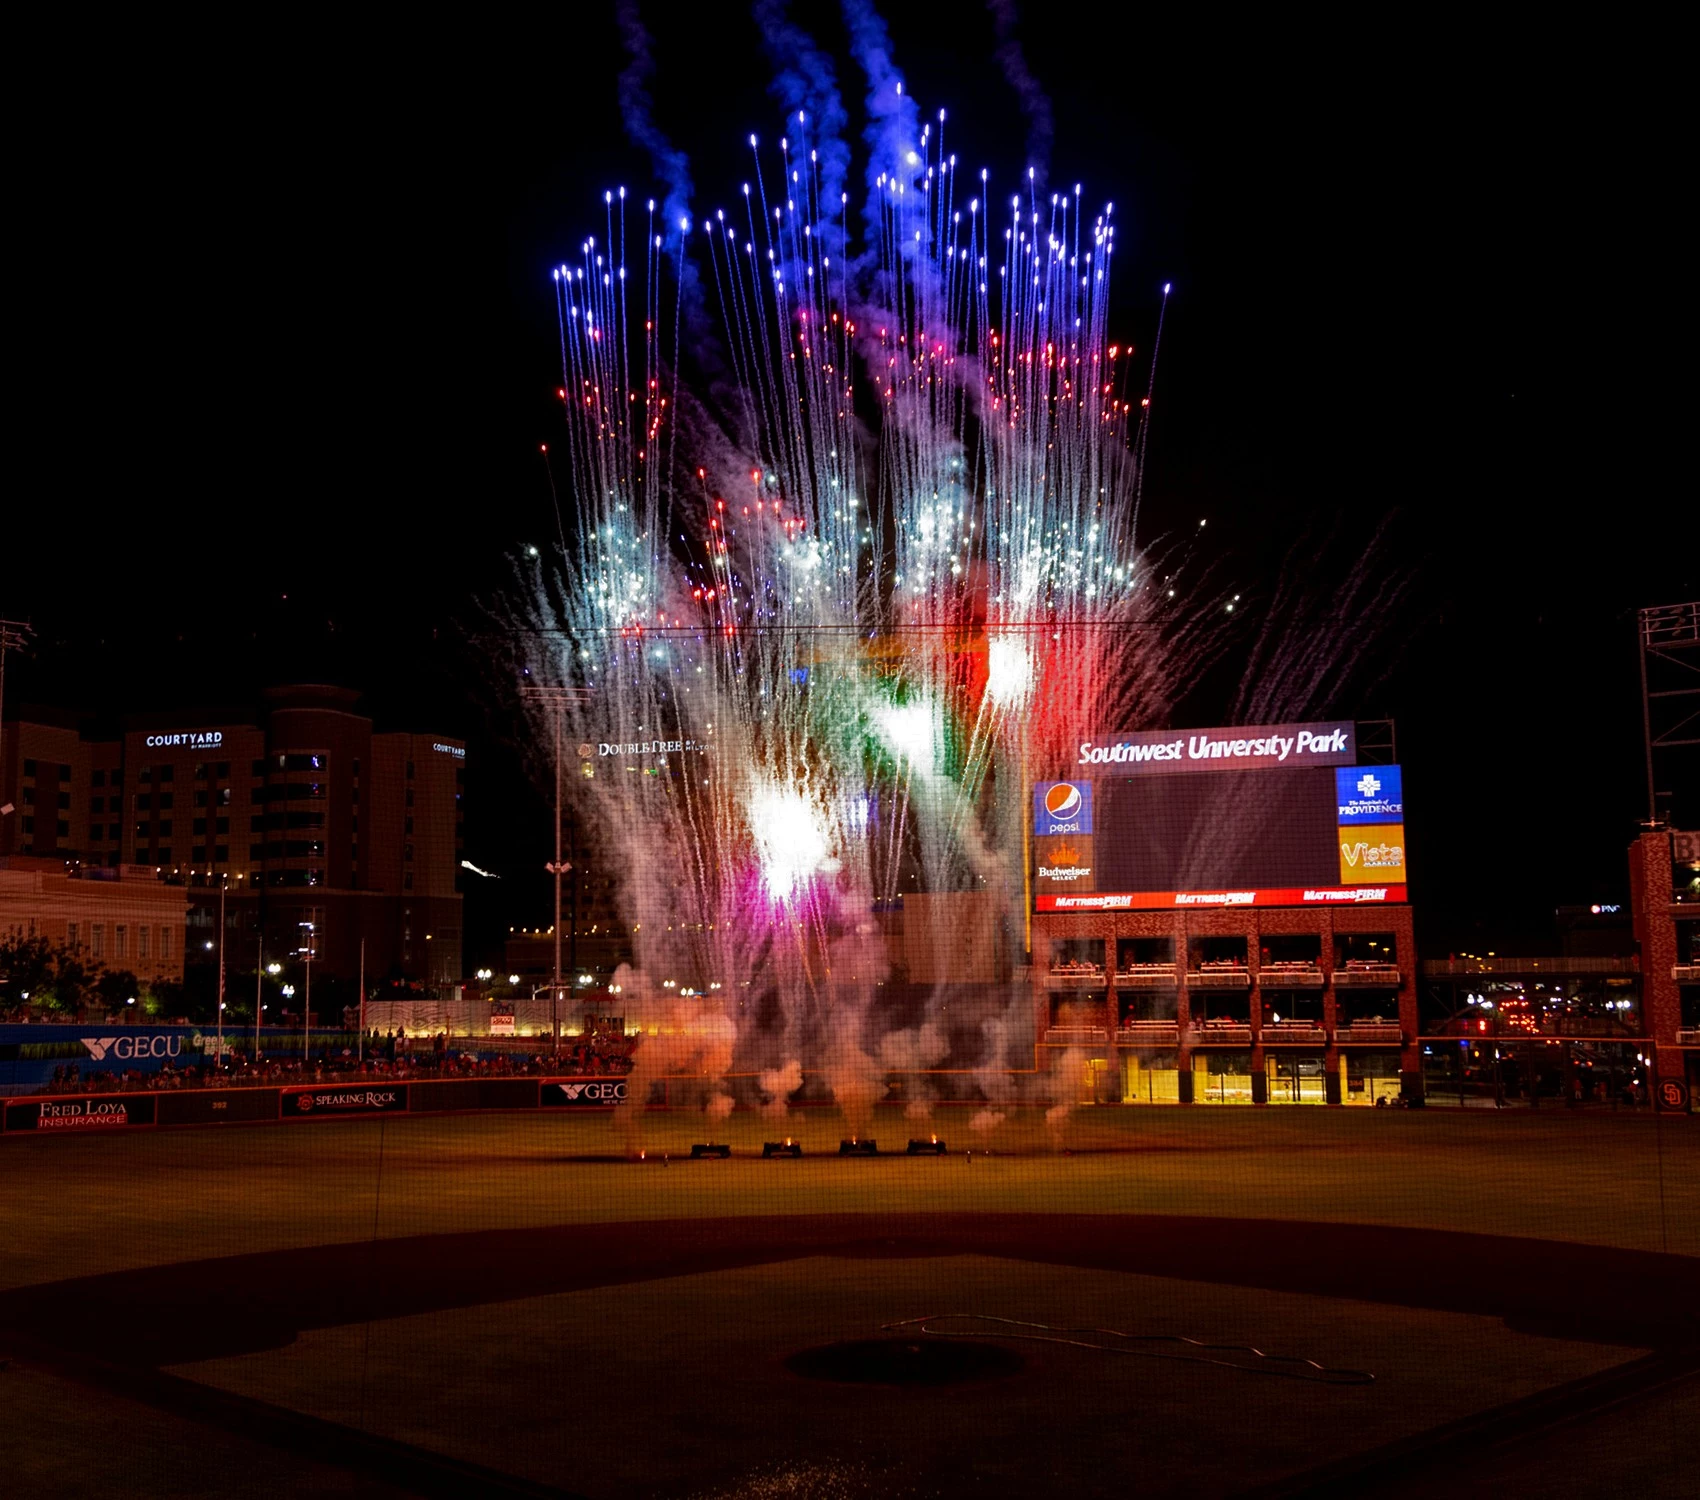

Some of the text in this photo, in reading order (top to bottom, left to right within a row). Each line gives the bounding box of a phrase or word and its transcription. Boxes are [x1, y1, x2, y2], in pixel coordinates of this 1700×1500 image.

[146, 731, 222, 747] COURTYARD
[1078, 728, 1349, 764] Southwest University Park
[433, 743, 466, 756] COURTYARD
[1338, 804, 1403, 815] PROVIDENCE
[1049, 822, 1080, 834] pepsi
[1341, 843, 1403, 867] Vista
[1038, 866, 1091, 877] Budweiser
[114, 1035, 182, 1059] GECU
[316, 1091, 396, 1107] SPEAKING ROCK
[40, 1100, 127, 1117] FRED LOYA
[40, 1114, 125, 1127] INSURANCE
